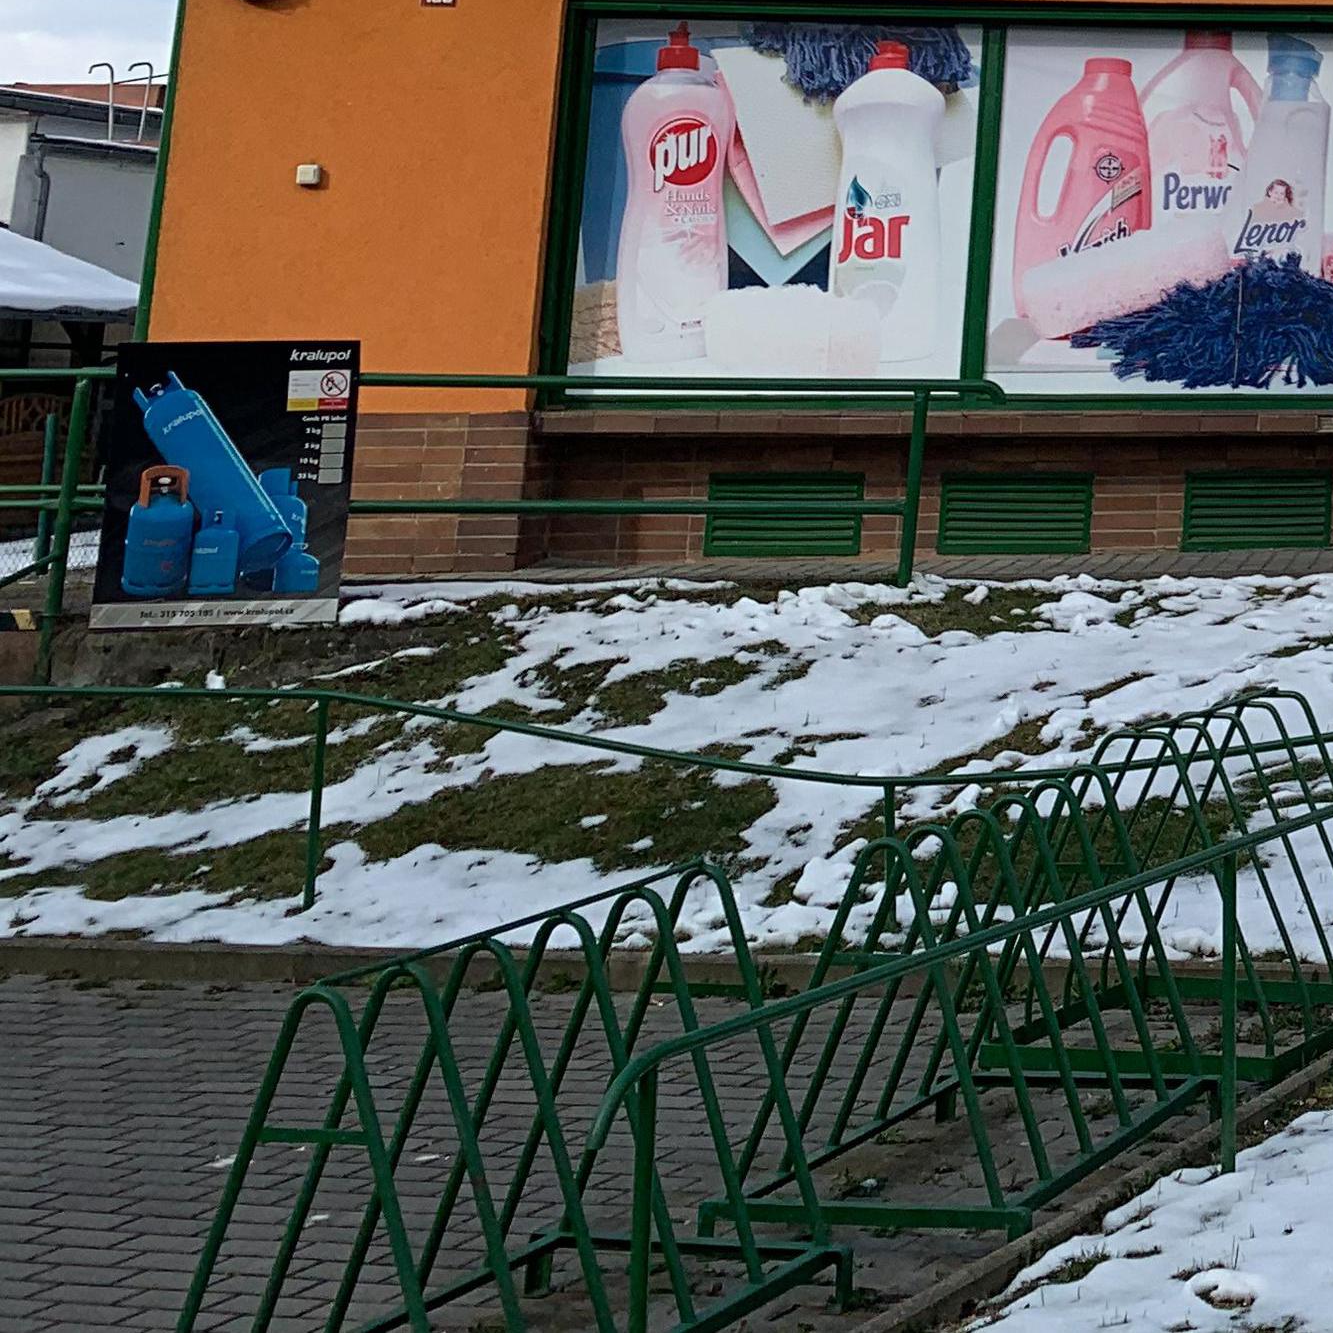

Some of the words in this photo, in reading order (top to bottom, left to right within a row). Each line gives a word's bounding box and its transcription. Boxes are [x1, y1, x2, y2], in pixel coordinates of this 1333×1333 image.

[653, 125, 712, 194] pur
[1234, 208, 1307, 254] Lenor
[290, 348, 352, 363] kralupol
